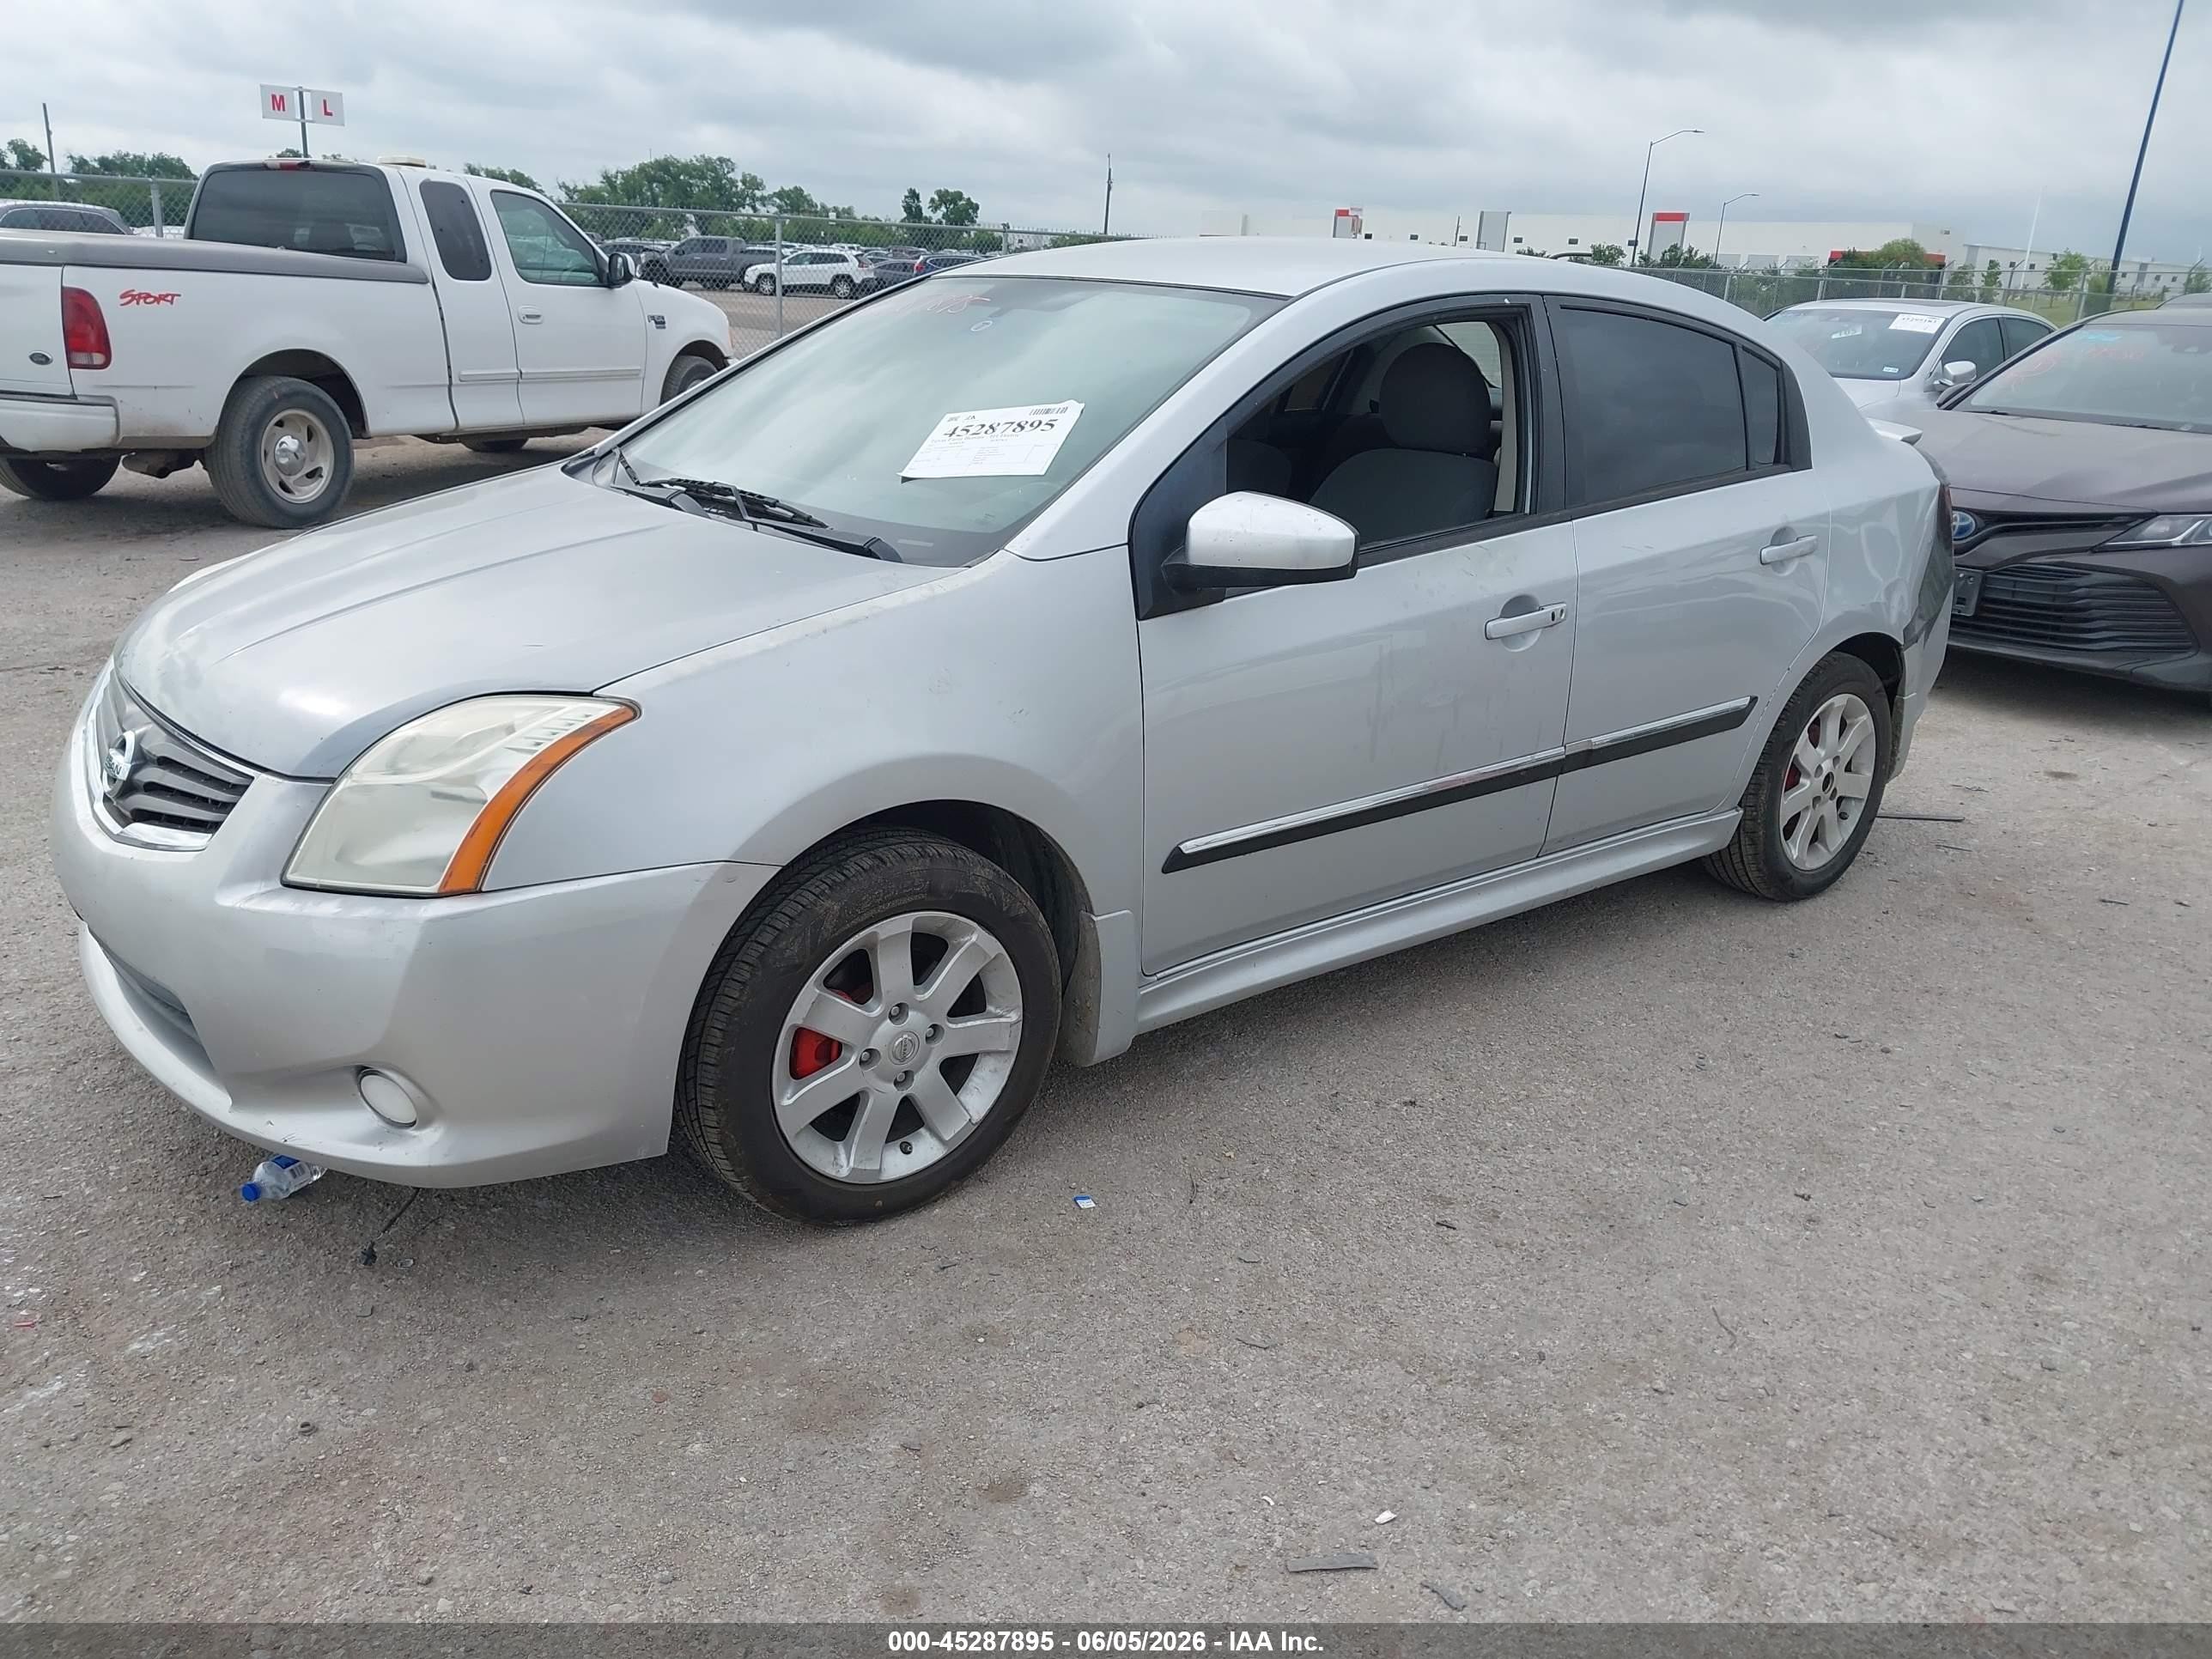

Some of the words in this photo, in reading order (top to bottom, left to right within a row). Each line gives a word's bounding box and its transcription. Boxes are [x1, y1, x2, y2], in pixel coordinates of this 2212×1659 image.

[270, 94, 286, 112] M
[322, 99, 333, 117] L
[119, 289, 181, 306] SPORT
[944, 418, 1058, 438] 45287895
